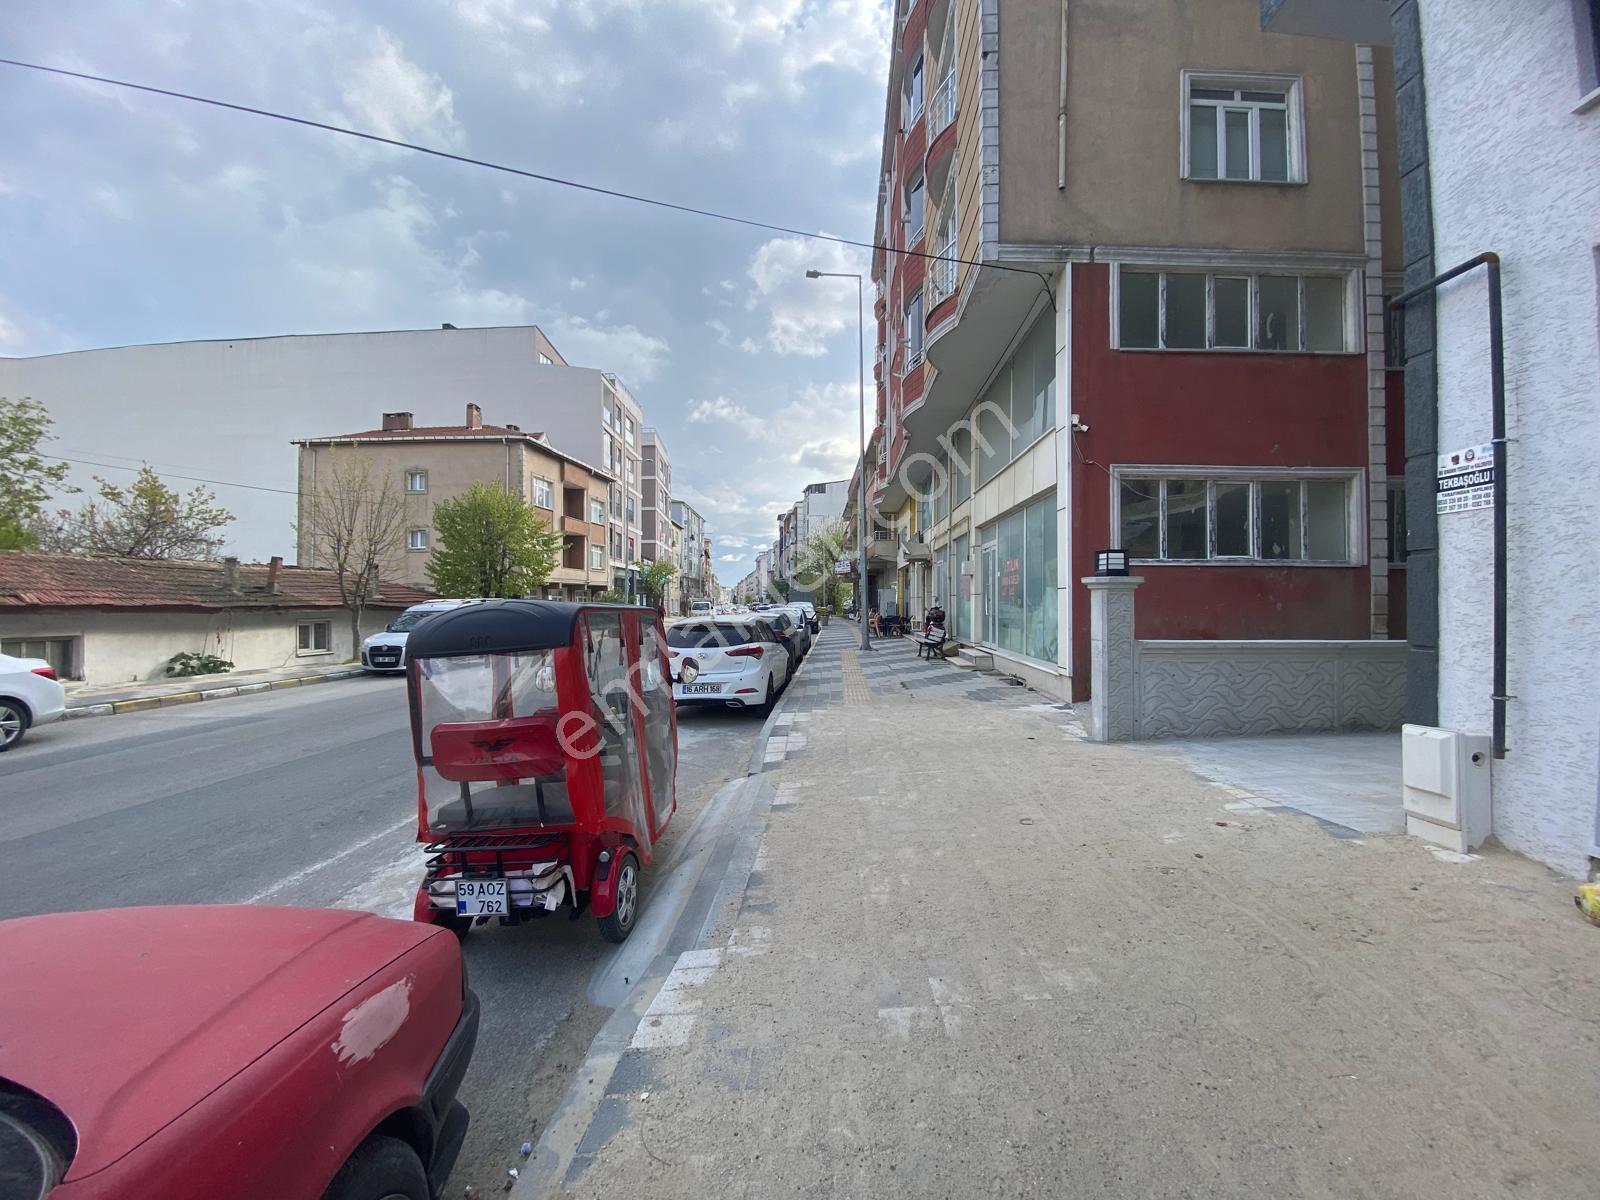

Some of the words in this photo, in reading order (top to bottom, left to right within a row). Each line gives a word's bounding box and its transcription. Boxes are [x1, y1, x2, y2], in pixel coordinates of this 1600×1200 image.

[1438, 470, 1490, 490] TEKBAŞOĞLU
[694, 685, 709, 694] ARH
[458, 883, 475, 896] 59
[477, 882, 505, 897] AOZ
[478, 900, 503, 914] 762
